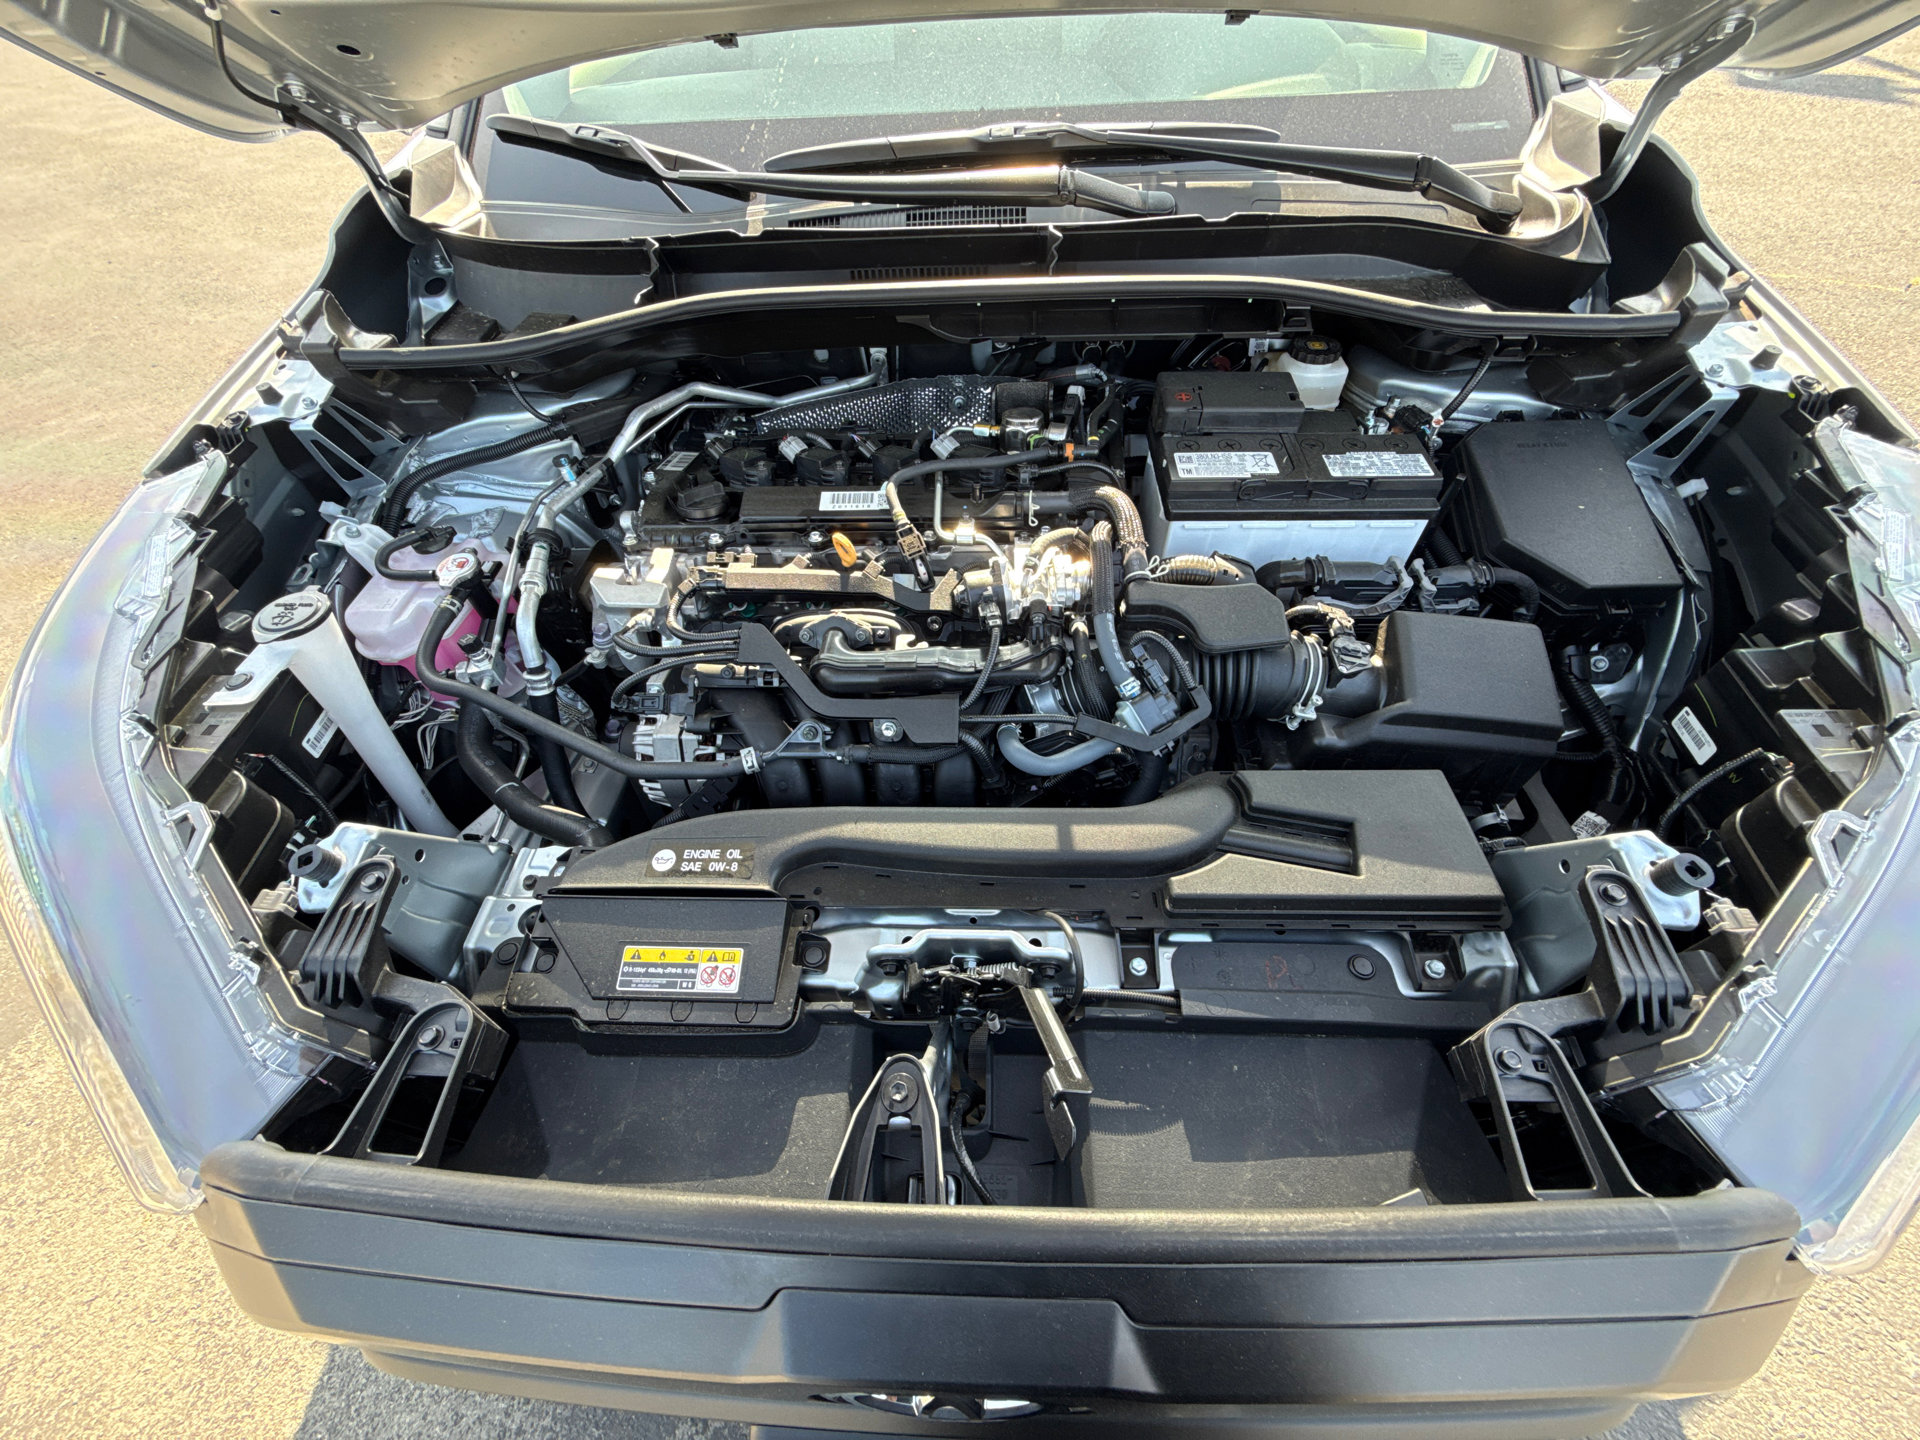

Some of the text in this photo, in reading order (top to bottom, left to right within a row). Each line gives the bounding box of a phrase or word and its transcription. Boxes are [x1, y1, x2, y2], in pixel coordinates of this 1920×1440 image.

[683, 849, 743, 859] ENGINE OIL
[680, 861, 739, 872] SAE 0W-8
